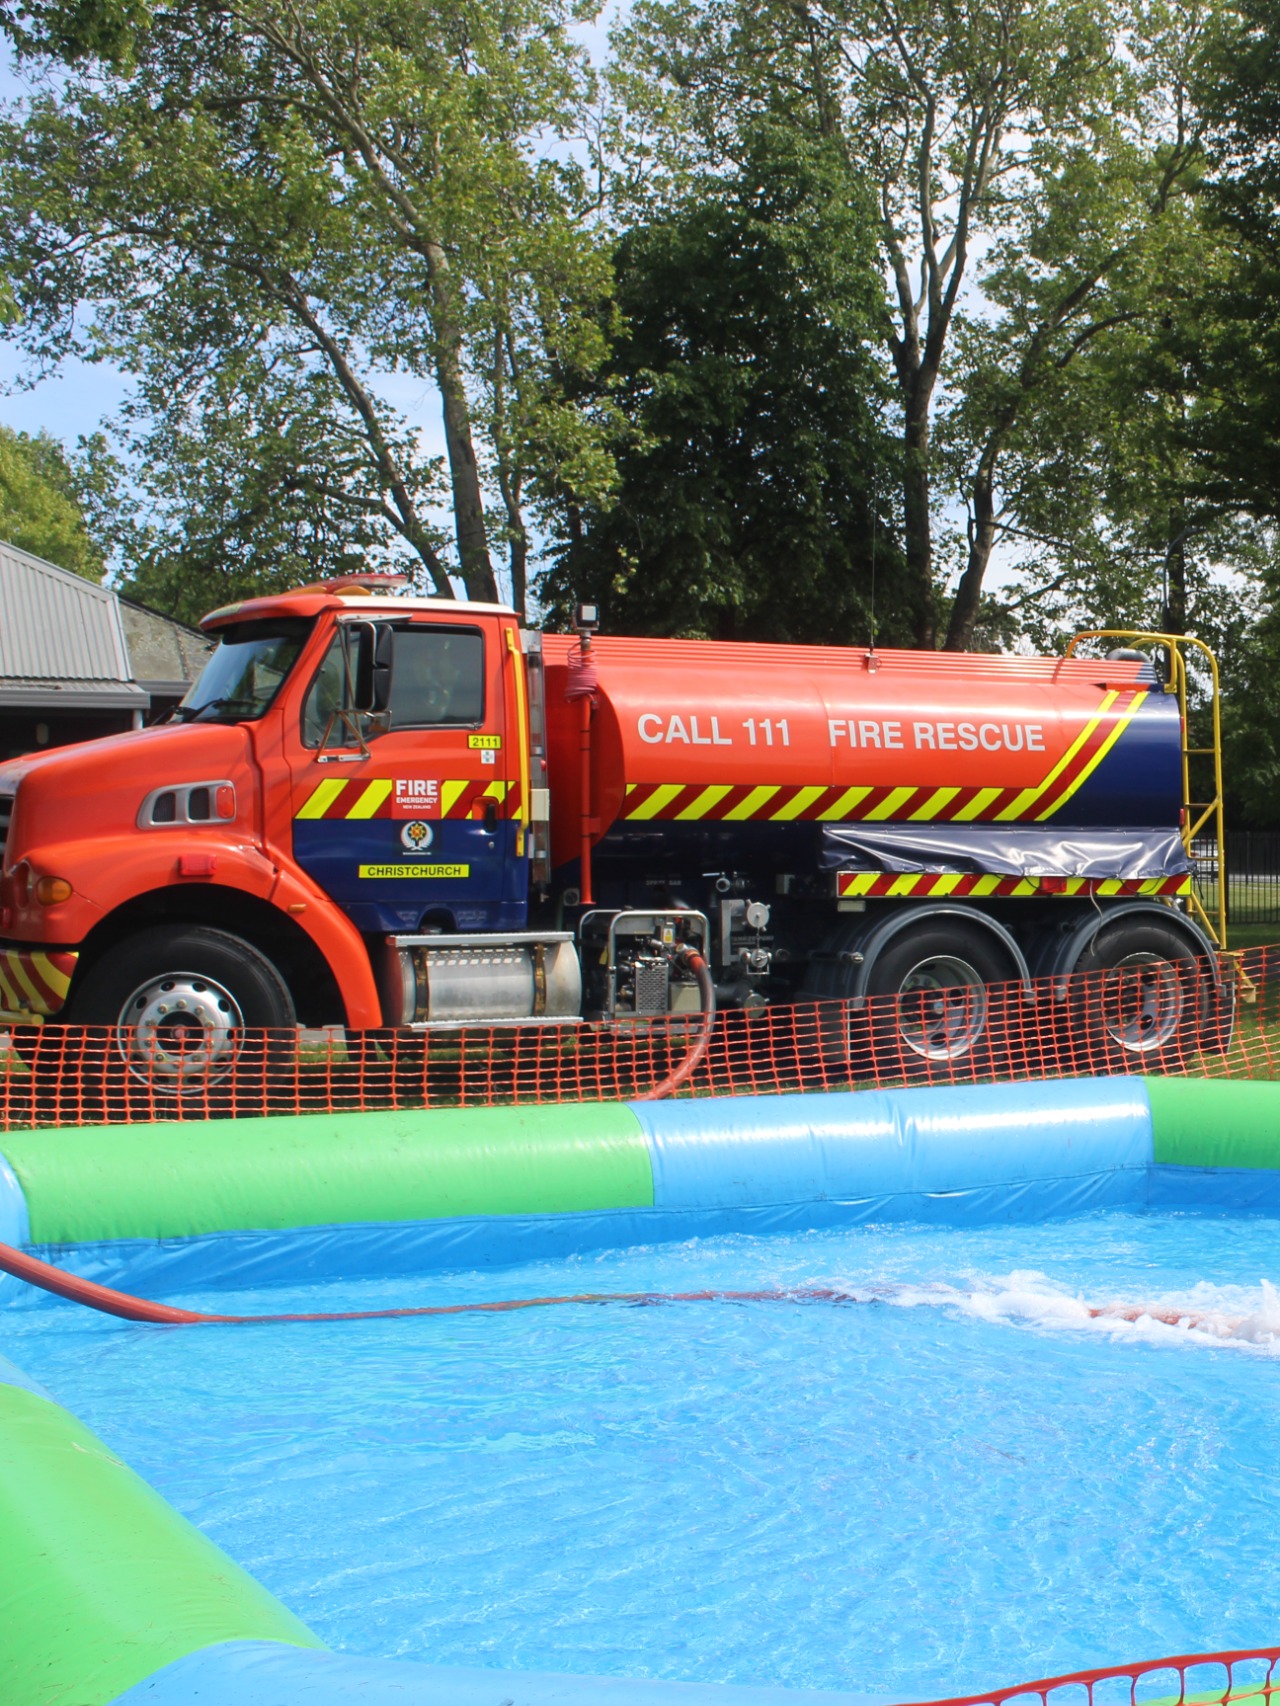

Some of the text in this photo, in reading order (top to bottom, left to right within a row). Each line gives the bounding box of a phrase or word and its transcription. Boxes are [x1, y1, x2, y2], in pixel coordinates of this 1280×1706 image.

[637, 713, 790, 746] CALL 111
[829, 719, 1046, 751] FIRE RESCUE
[472, 736, 498, 747] 2111
[396, 779, 438, 796] FIRE
[367, 866, 462, 876] CHRISTCHURCH
